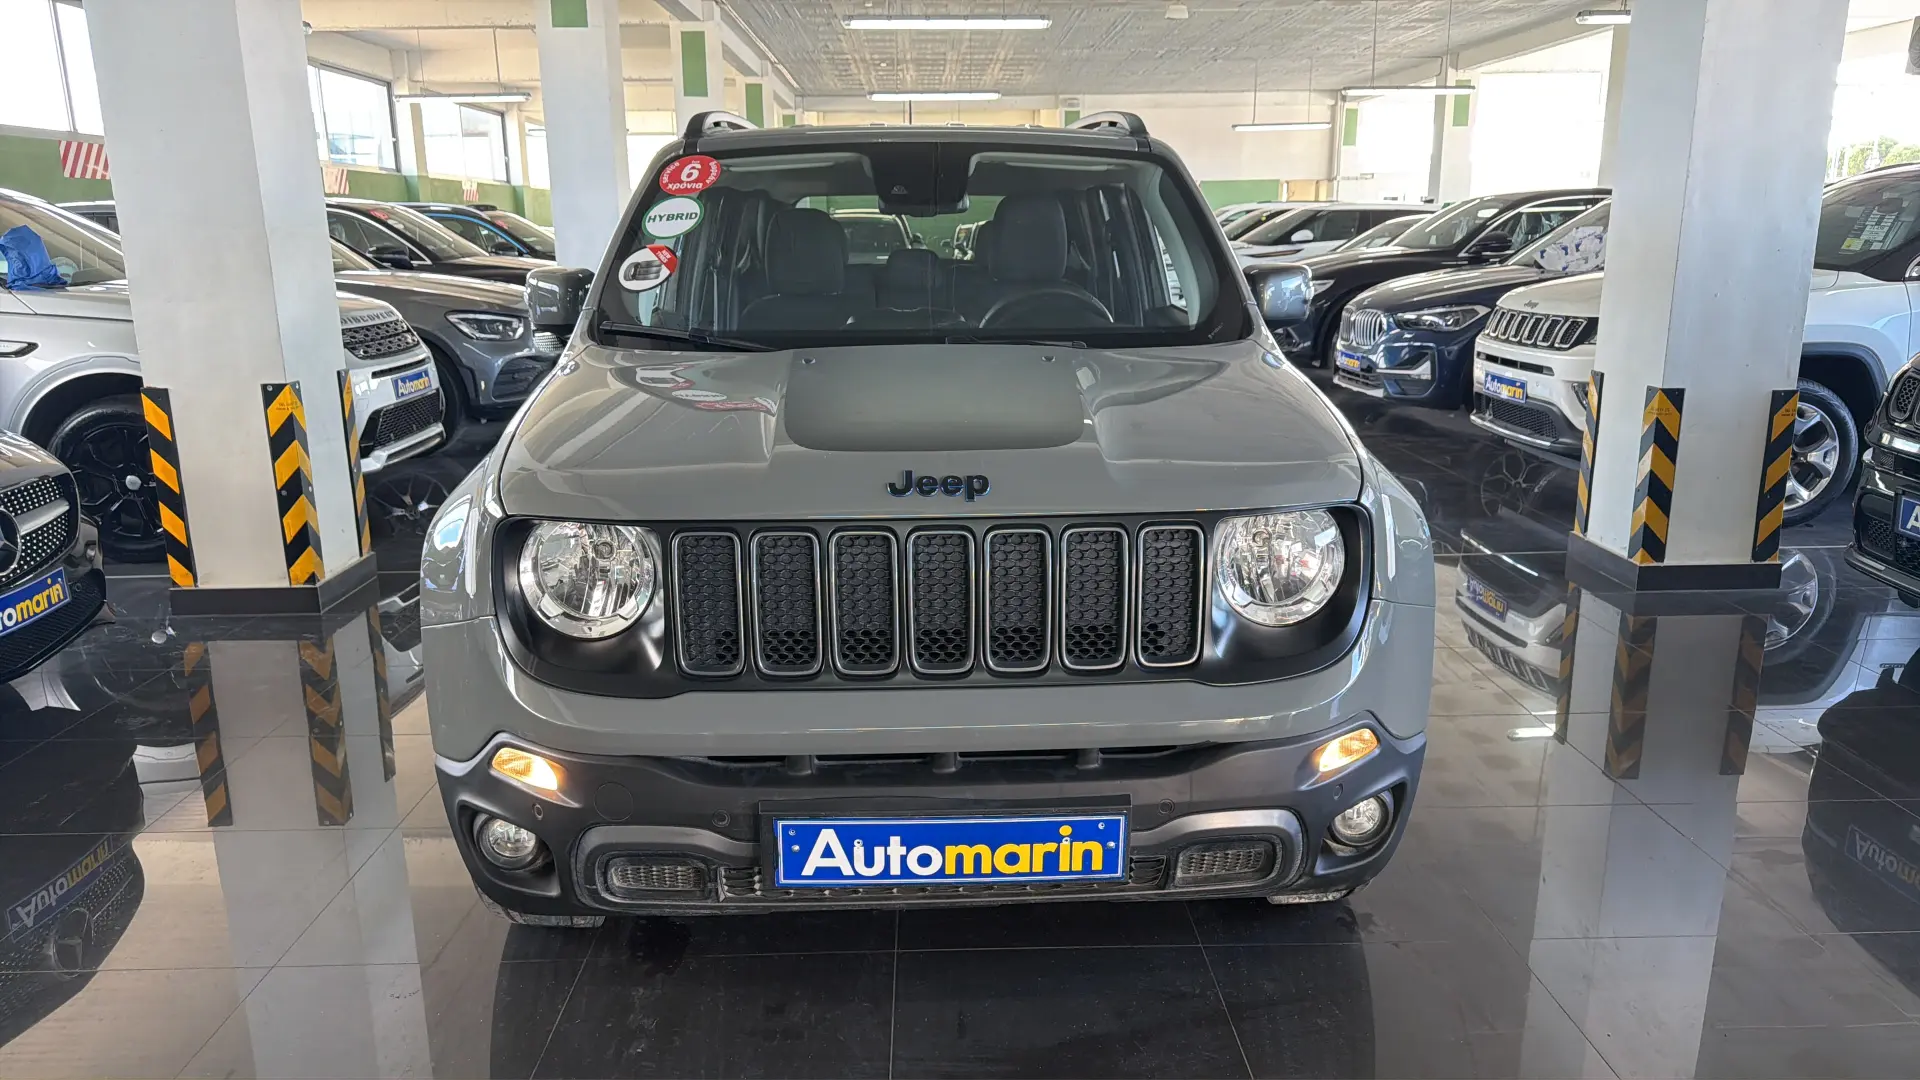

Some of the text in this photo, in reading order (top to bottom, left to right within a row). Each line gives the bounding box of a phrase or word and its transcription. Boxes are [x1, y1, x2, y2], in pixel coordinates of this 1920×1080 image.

[681, 163, 702, 182] 6
[647, 211, 699, 224] HYBRID
[1485, 374, 1524, 400] Automarin
[886, 470, 991, 502] Jeep
[801, 825, 1103, 877] Automarin
